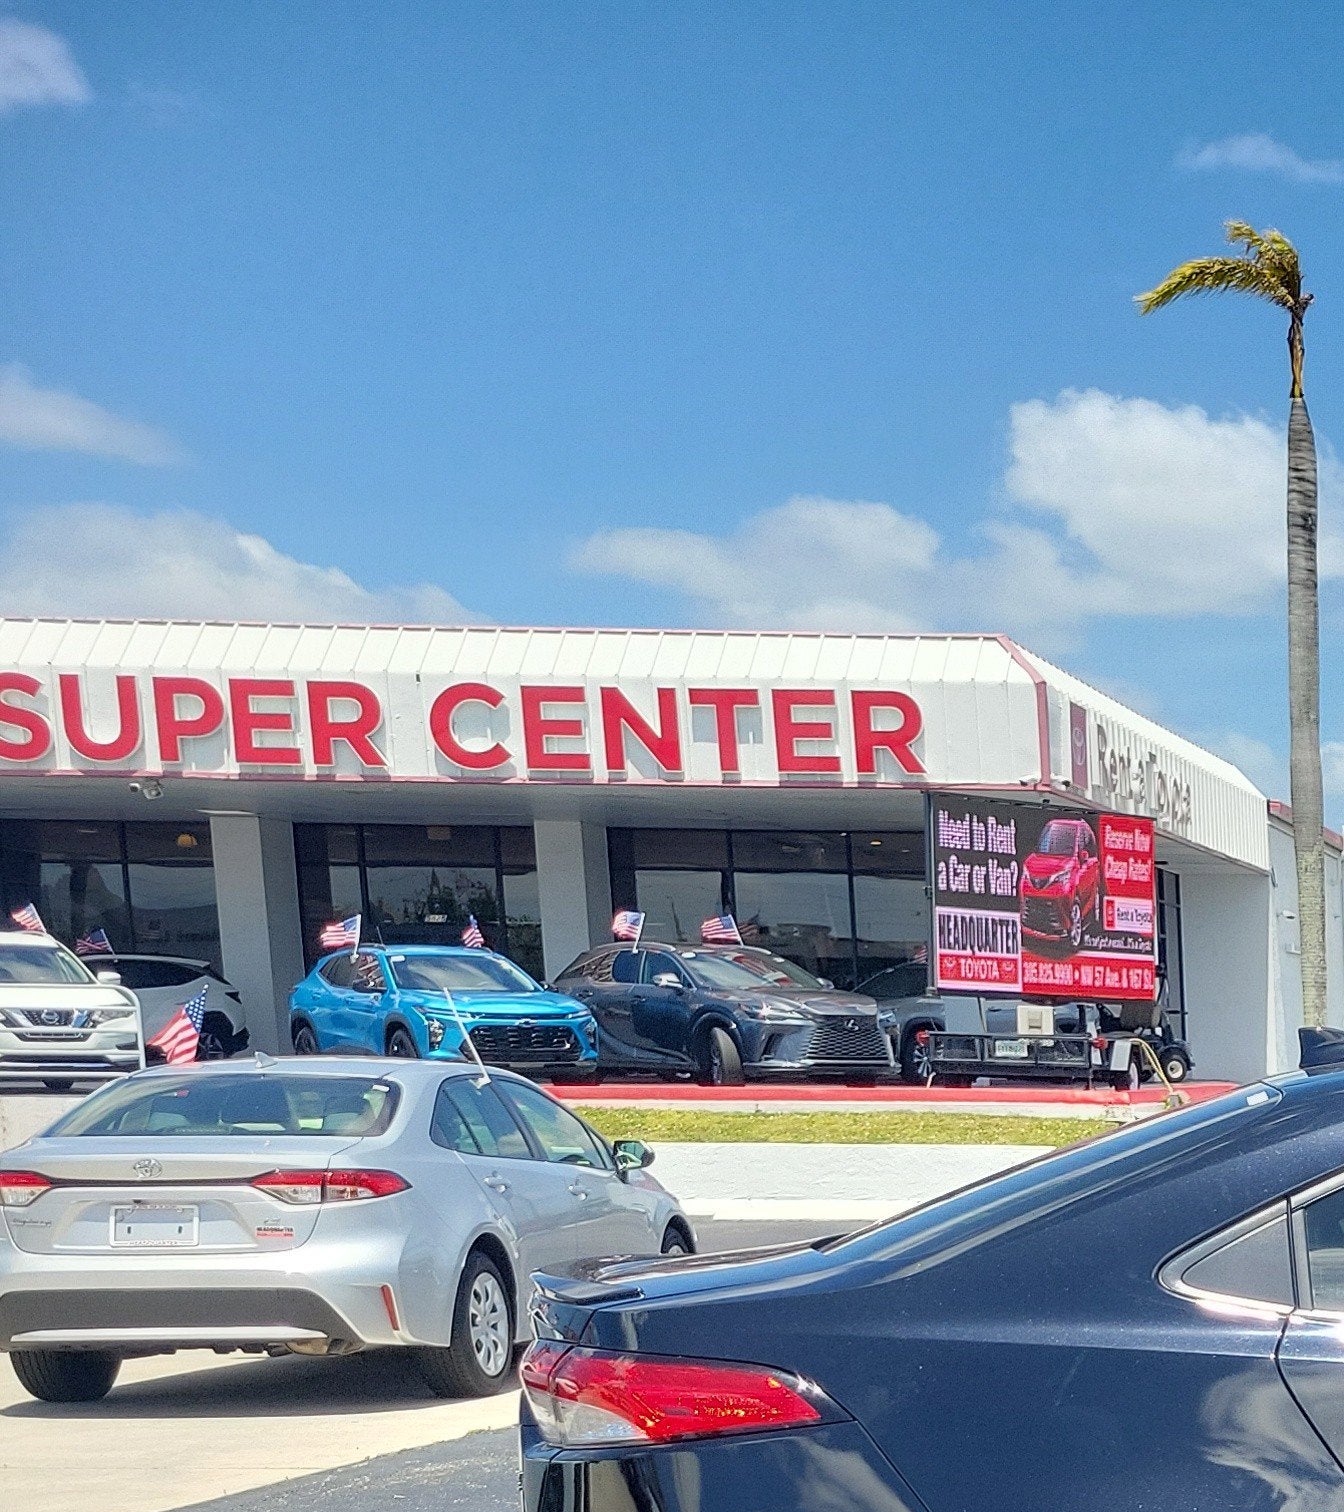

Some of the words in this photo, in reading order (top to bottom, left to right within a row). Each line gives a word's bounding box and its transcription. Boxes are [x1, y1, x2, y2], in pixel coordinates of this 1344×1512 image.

[0, 673, 385, 767] SUPER
[428, 682, 925, 774] CENTER
[938, 809, 971, 850] Need
[972, 814, 986, 851] to
[987, 815, 1017, 856] Rent
[937, 860, 948, 891] a
[949, 854, 971, 893] Car
[972, 864, 987, 894] or
[988, 858, 1019, 897] Van?
[938, 913, 1019, 955] HEADQUARTER
[960, 957, 1000, 980] TOYOTA
